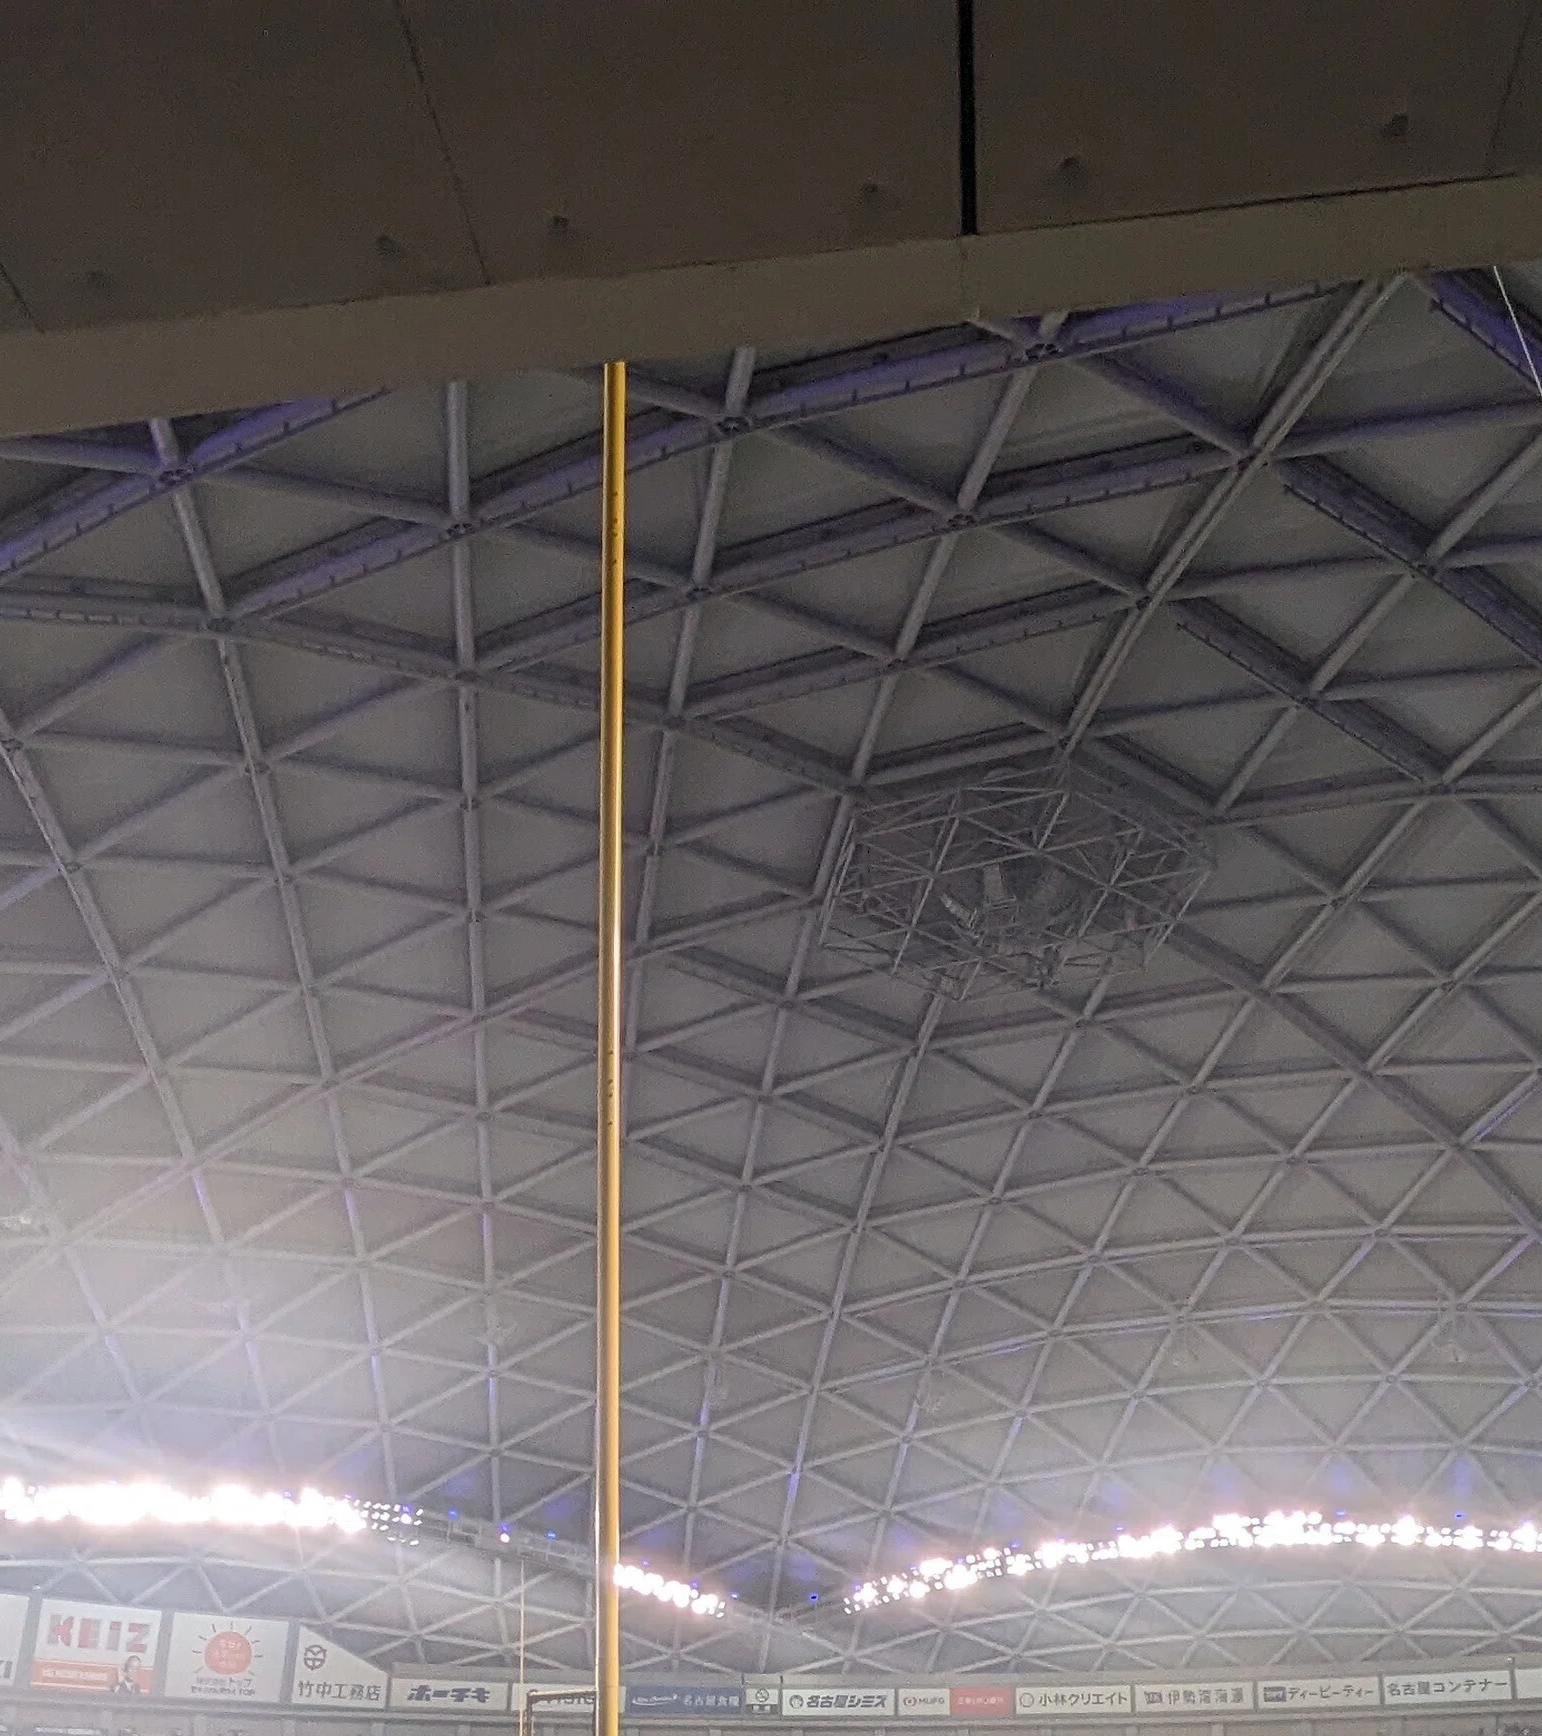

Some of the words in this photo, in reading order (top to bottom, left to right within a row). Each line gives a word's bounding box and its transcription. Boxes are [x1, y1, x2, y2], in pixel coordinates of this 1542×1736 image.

[46, 1614, 151, 1654] KEIZ
[298, 1680, 382, 1702] 竹中工務店
[408, 1684, 491, 1703] ホーチキ
[1039, 1692, 1128, 1708] 小林クリエイト
[918, 1697, 945, 1706] MUFG
